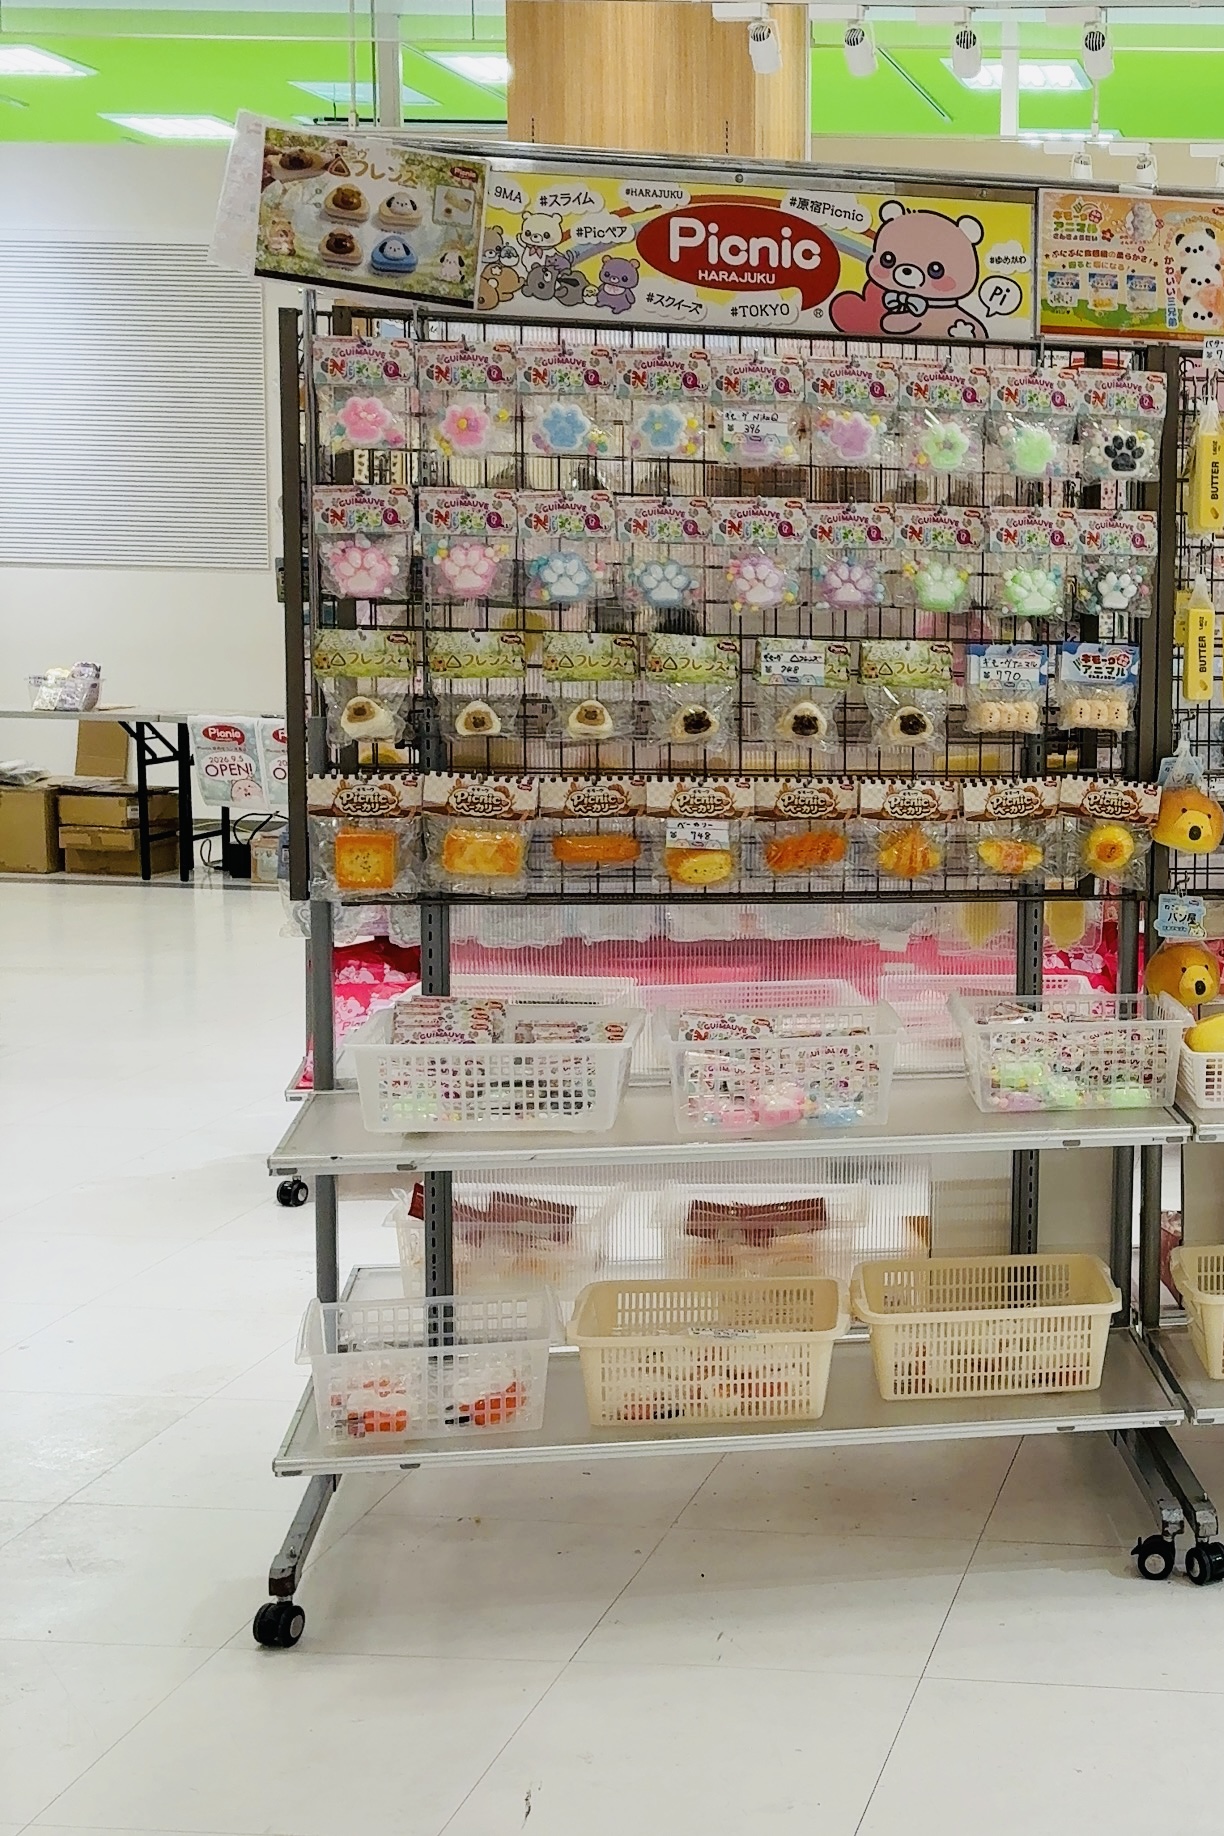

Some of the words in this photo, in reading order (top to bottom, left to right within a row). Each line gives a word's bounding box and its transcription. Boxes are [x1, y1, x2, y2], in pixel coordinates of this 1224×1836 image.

[539, 191, 595, 207] #スライム
[625, 187, 683, 200] #HARAJUKU
[789, 196, 865, 223] #原宿Picnic
[576, 226, 628, 239] #Picベア
[668, 216, 822, 269] Picnic
[698, 268, 776, 285] HARAJUKU
[988, 284, 1011, 307] Pi
[646, 292, 703, 314] #スクイーズ
[730, 303, 790, 318] #TOKYO
[1210, 461, 1220, 500] BUTTER
[1198, 635, 1207, 673] BUTTER
[1081, 664, 1126, 677] アニマル
[205, 763, 253, 777] OPEN!
[340, 791, 388, 804] Picnic
[454, 790, 502, 805] Picnic
[573, 792, 618, 805] Picnic
[677, 793, 723, 806] Picnic
[782, 794, 827, 806] Picnic
[890, 795, 930, 808] Picnic
[991, 794, 1033, 808] Picnic
[1087, 794, 1130, 808] Picnic
